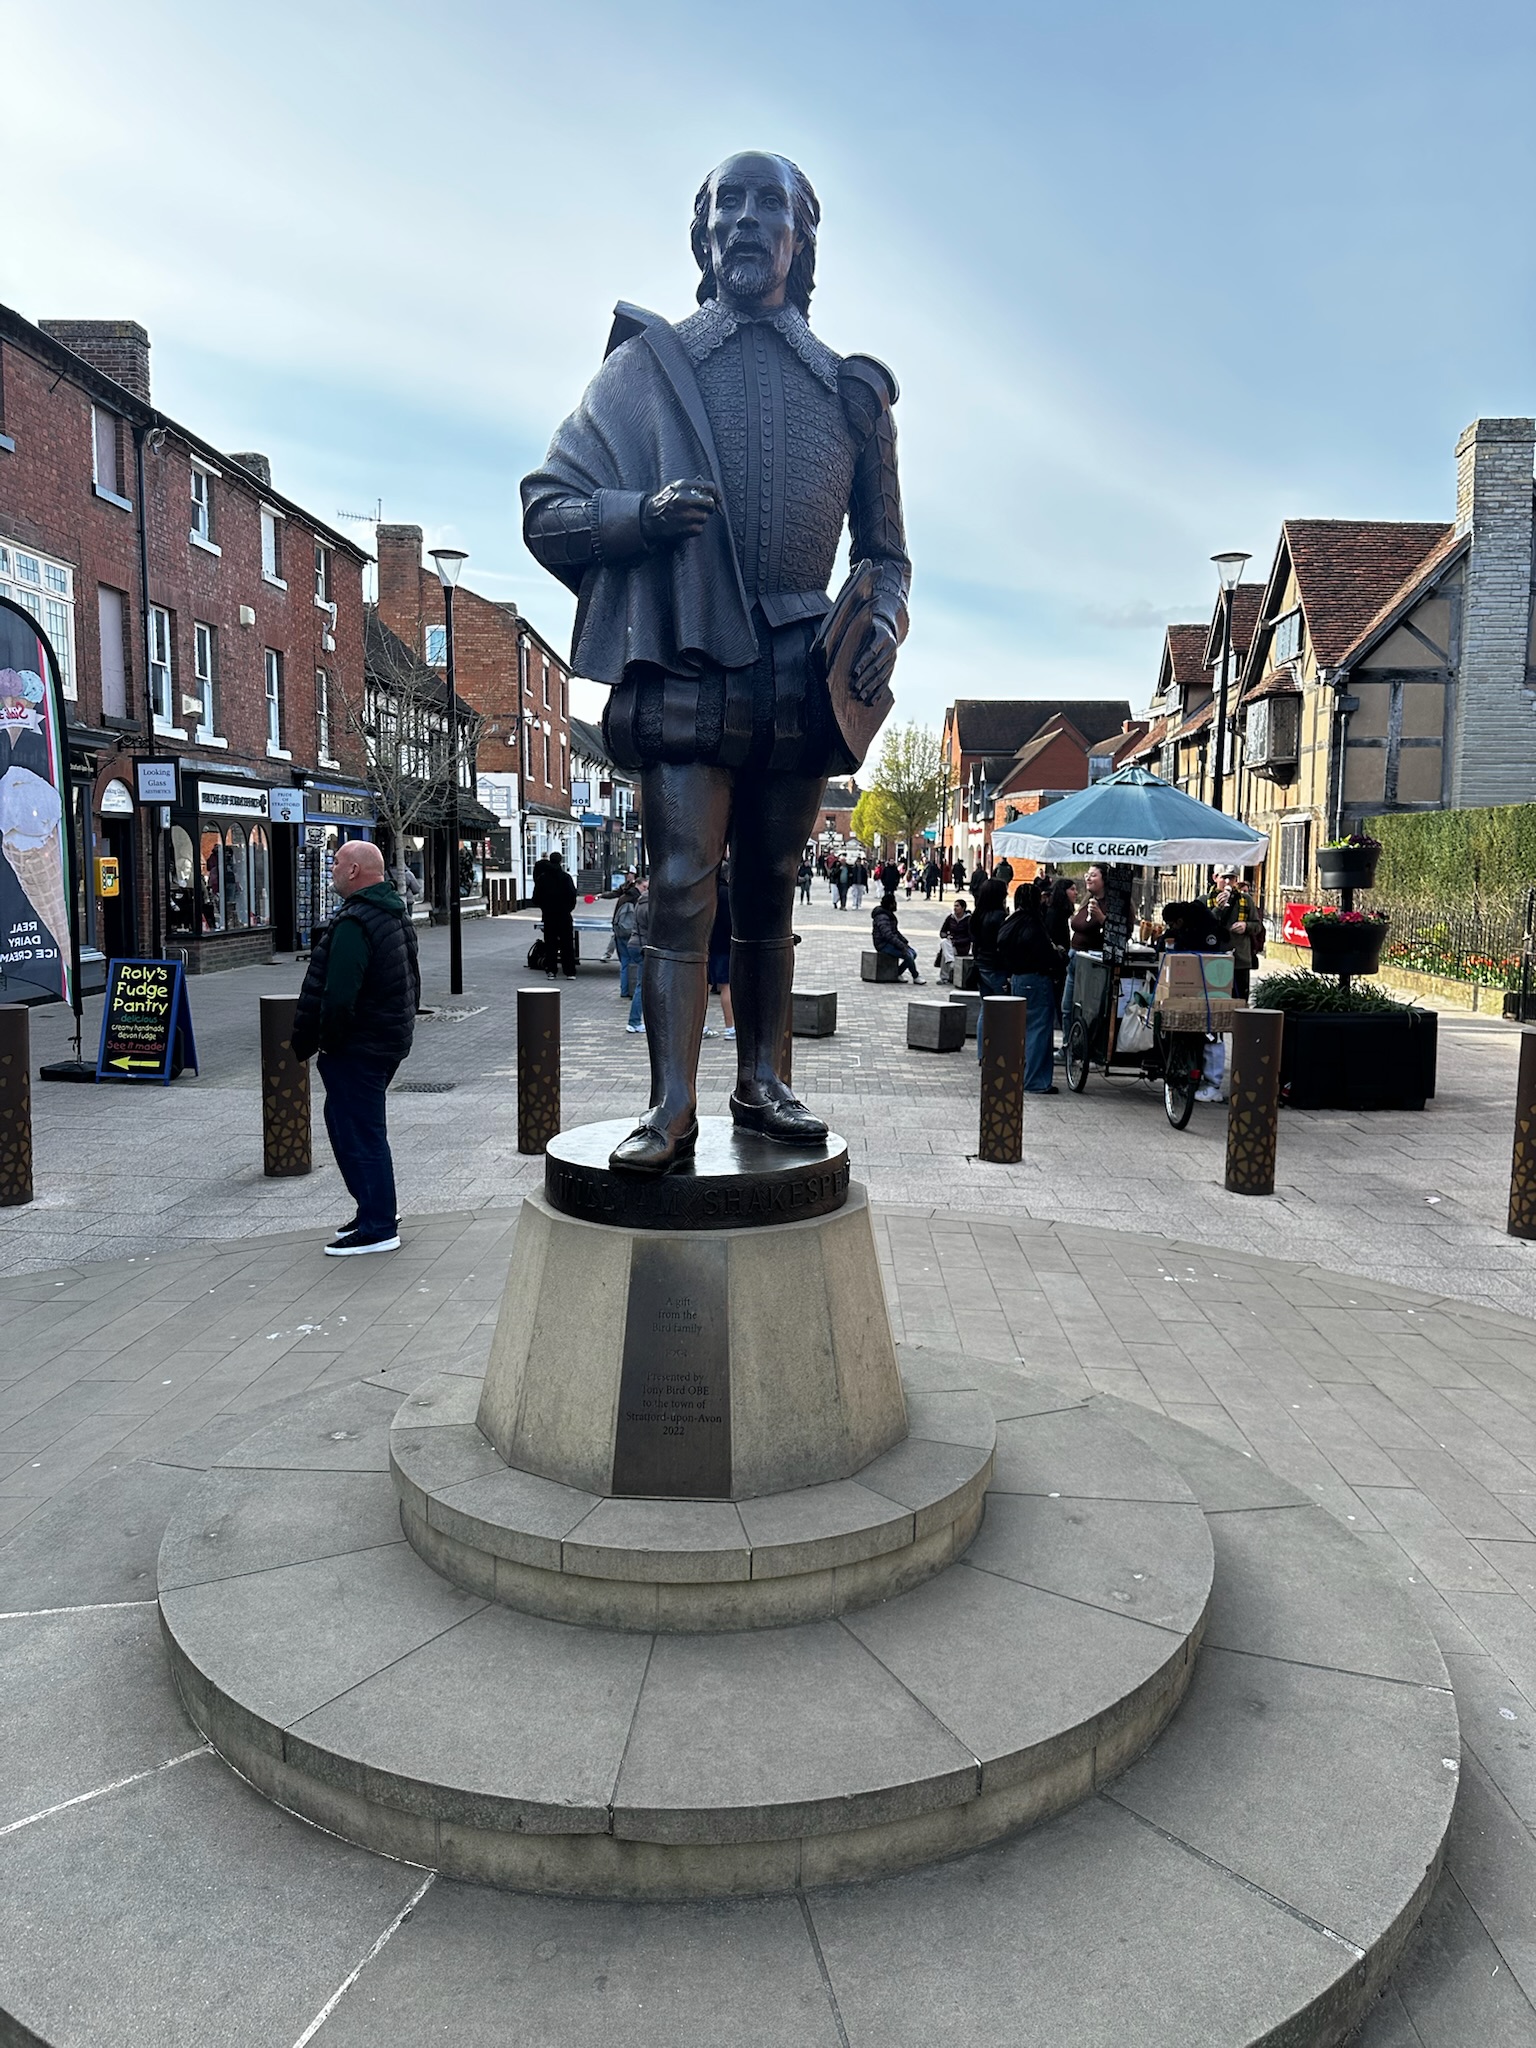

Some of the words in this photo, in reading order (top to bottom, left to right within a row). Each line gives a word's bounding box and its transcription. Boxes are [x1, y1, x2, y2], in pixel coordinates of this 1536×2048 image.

[143, 768, 171, 777] Looking
[1072, 842, 1094, 855] ICE
[1098, 843, 1149, 857] CREAM
[121, 966, 168, 982] Roly's
[116, 982, 168, 999] Fudge
[113, 998, 168, 1015] Pantry
[121, 1014, 158, 1023] delicious
[111, 1024, 134, 1032] creamy
[134, 1024, 165, 1033] handmade
[138, 1032, 157, 1041] fudge
[107, 1040, 126, 1050] See
[704, 1158, 850, 1215] SHAKESPEA
[665, 1297, 673, 1306] A
[676, 1297, 690, 1308] gift
[658, 1310, 680, 1319] from
[683, 1310, 697, 1319] the
[652, 1323, 671, 1332] Bird
[674, 1323, 703, 1335] family
[647, 1372, 690, 1381] Presented
[693, 1372, 704, 1384] by
[643, 1385, 664, 1397] Tony
[666, 1386, 685, 1395] Bird
[688, 1386, 709, 1396] OBE
[642, 1400, 652, 1408] to
[654, 1399, 669, 1408] the
[671, 1400, 694, 1409] town
[696, 1399, 706, 1409] of
[626, 1411, 722, 1425] Stratford-upon-Avon
[663, 1426, 685, 1436] 2022
